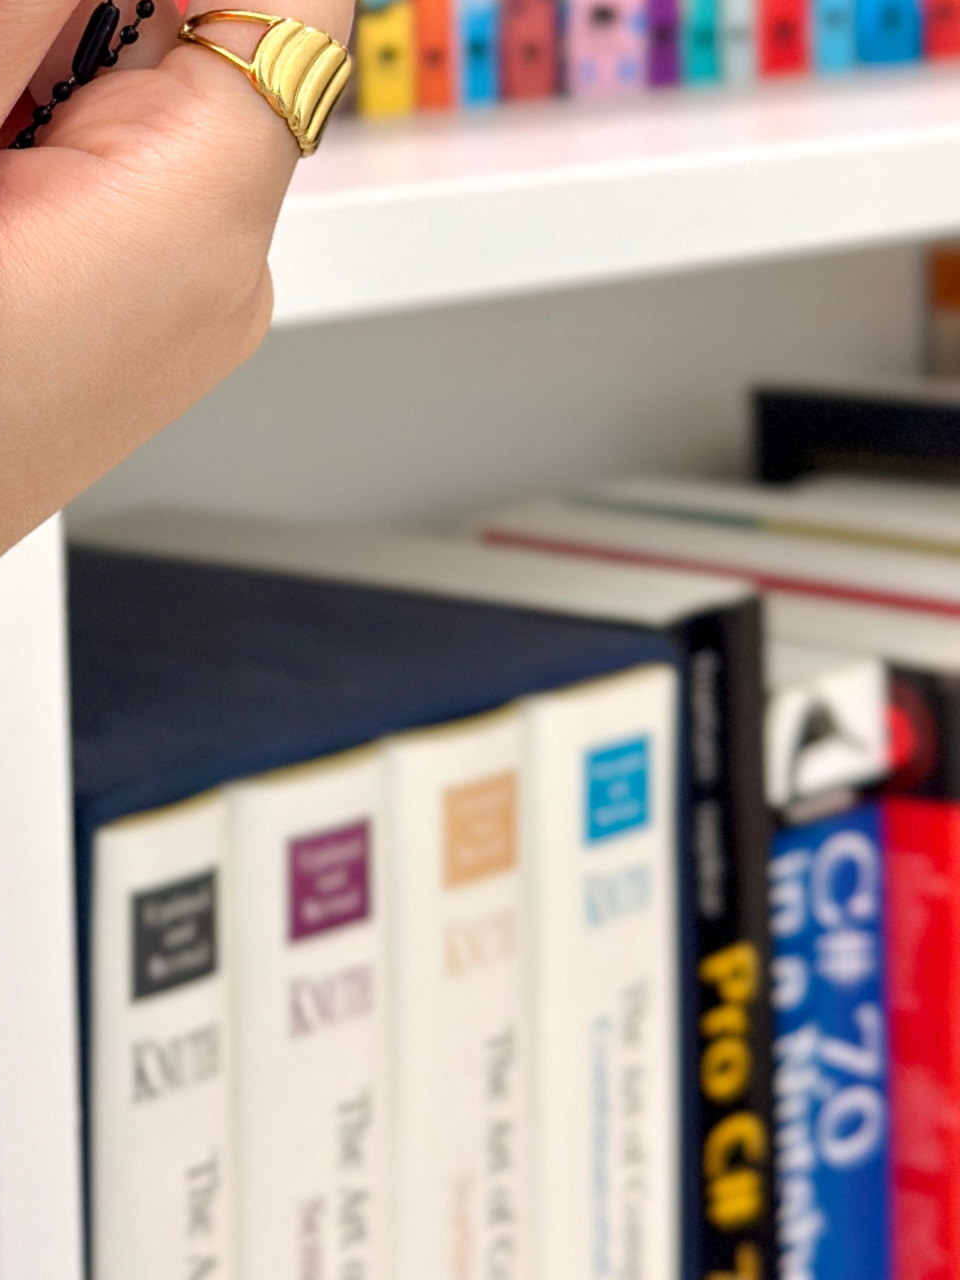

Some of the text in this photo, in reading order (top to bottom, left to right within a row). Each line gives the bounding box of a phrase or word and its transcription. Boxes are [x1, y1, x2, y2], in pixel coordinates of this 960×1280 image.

[811, 830, 881, 985] C#
[697, 942, 761, 1103] Pro
[704, 1111, 768, 1232] C#
